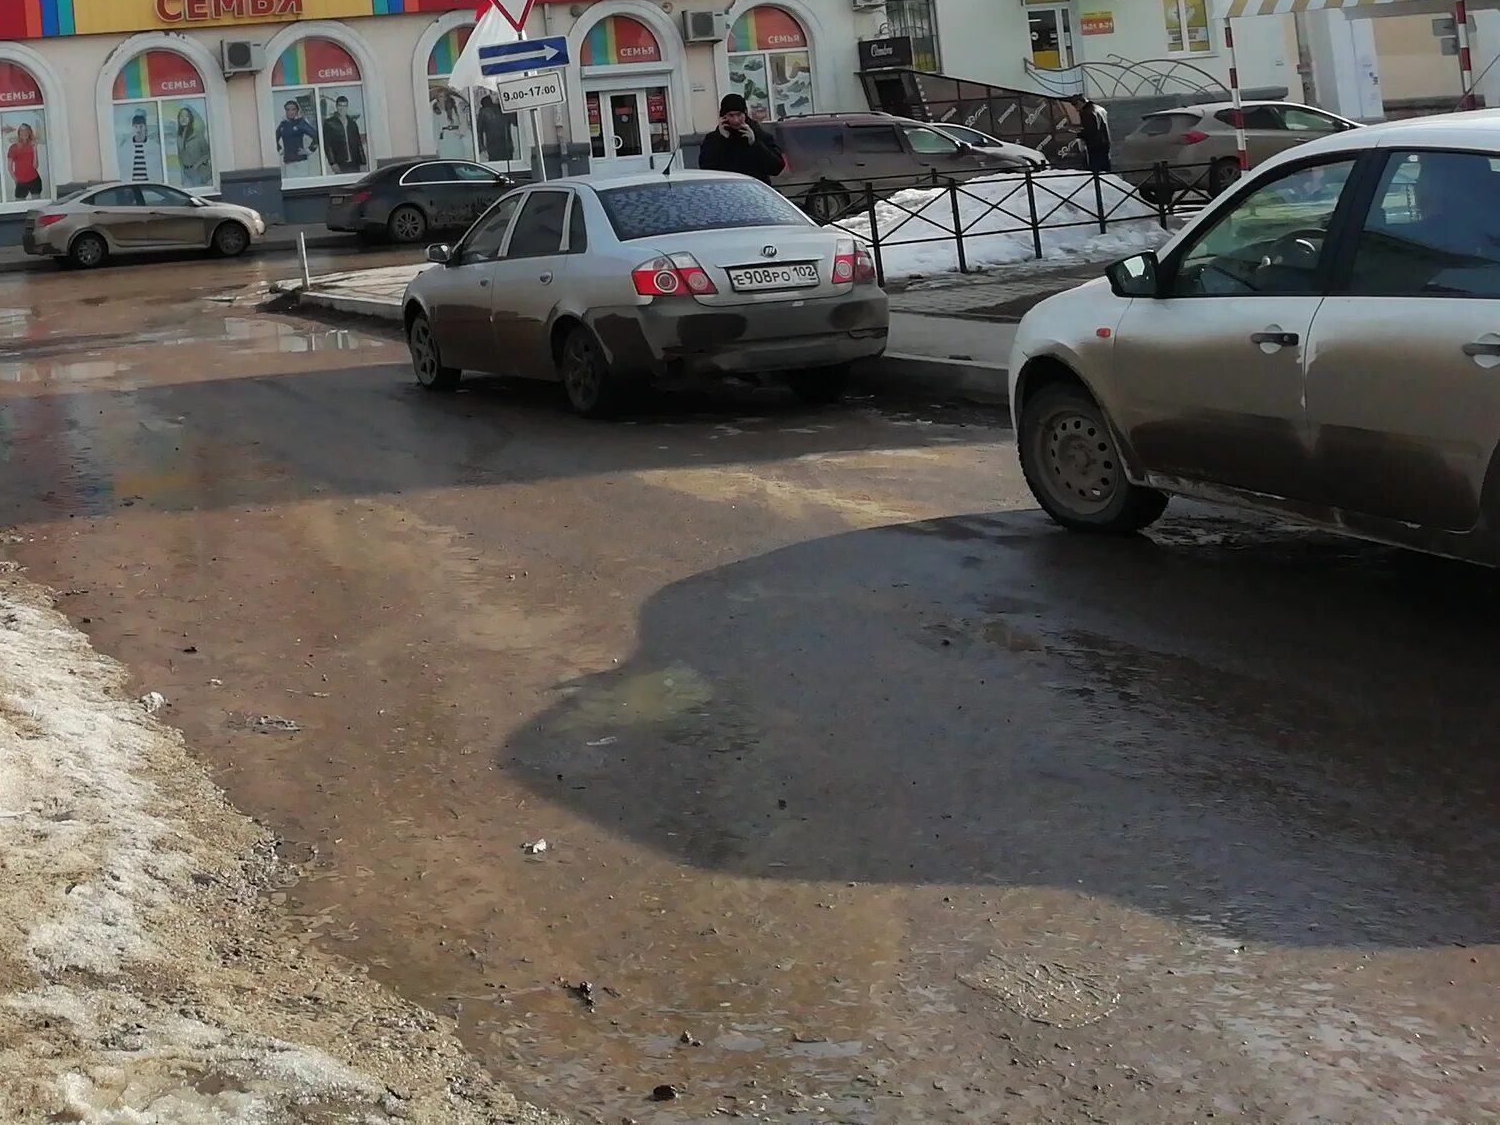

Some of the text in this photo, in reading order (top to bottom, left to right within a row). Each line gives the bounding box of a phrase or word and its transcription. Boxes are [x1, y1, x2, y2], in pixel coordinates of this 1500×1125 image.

[768, 34, 800, 44] СЕМЬЯ
[621, 46, 655, 57] СЕМЬЯ
[318, 67, 353, 78] СЕМЬЯ
[161, 79, 197, 90] СЕМЬЯ
[0, 90, 36, 102] СЕМЬЯ
